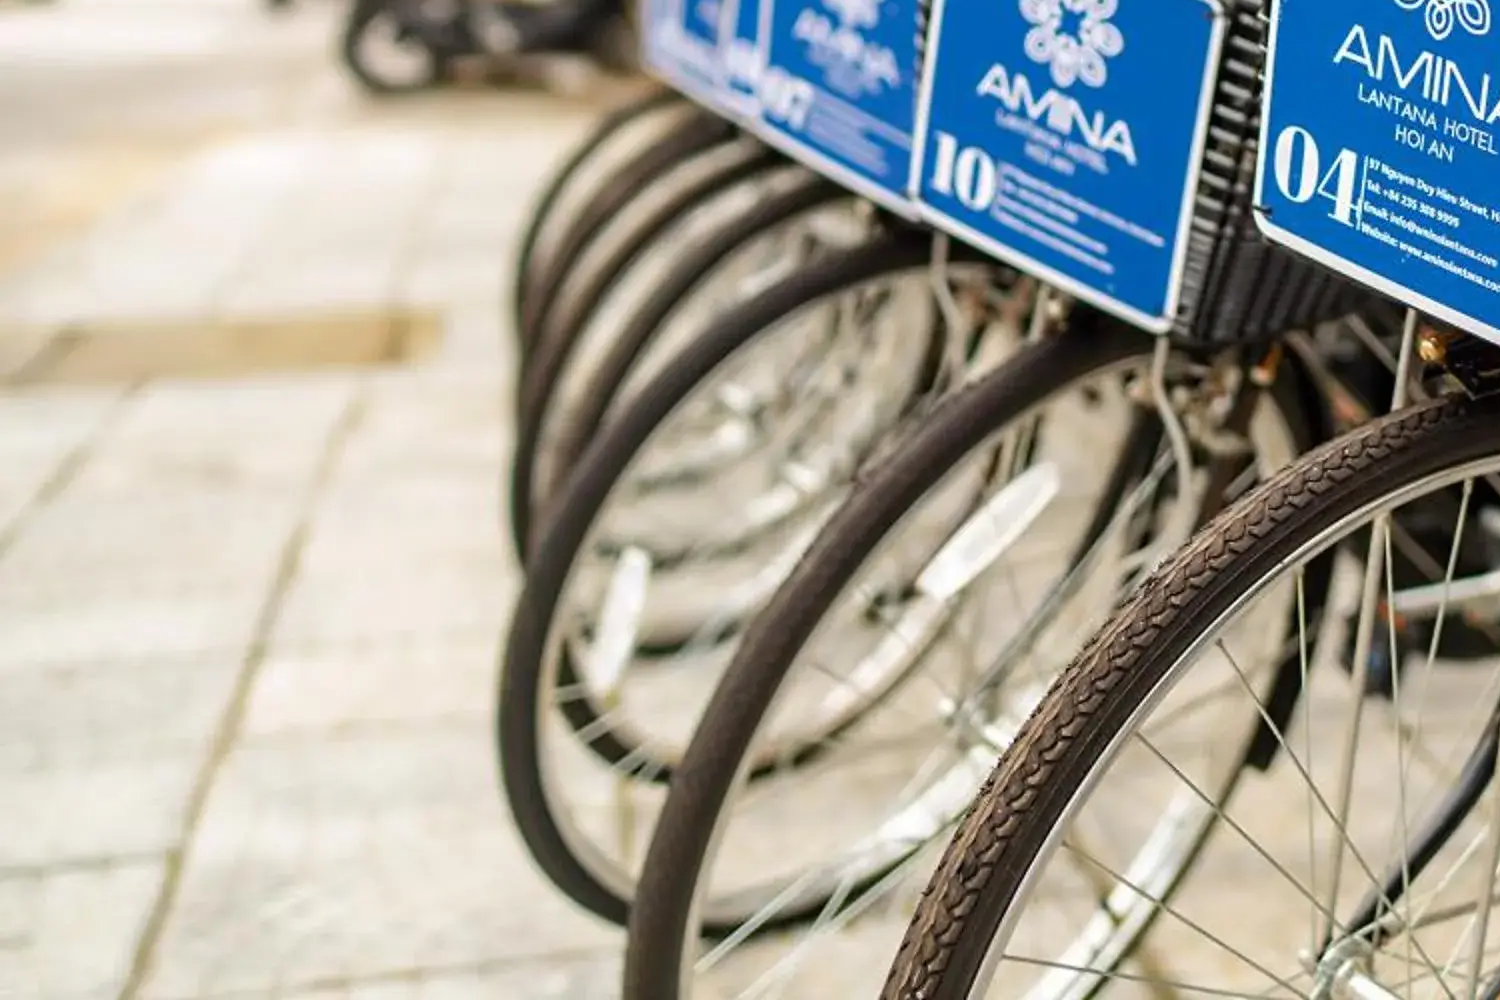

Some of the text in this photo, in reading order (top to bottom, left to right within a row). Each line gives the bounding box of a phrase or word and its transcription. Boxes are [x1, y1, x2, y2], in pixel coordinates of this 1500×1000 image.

[978, 65, 1135, 163] AMINA
[1359, 84, 1497, 154] LANTANA HOTEL
[1396, 125, 1453, 162] HOI AN
[933, 133, 999, 209] 10
[1275, 127, 1360, 226] 04
[1381, 164, 1417, 186] Nguyen
[1416, 178, 1436, 196] Duy
[1459, 197, 1489, 219] Street,
